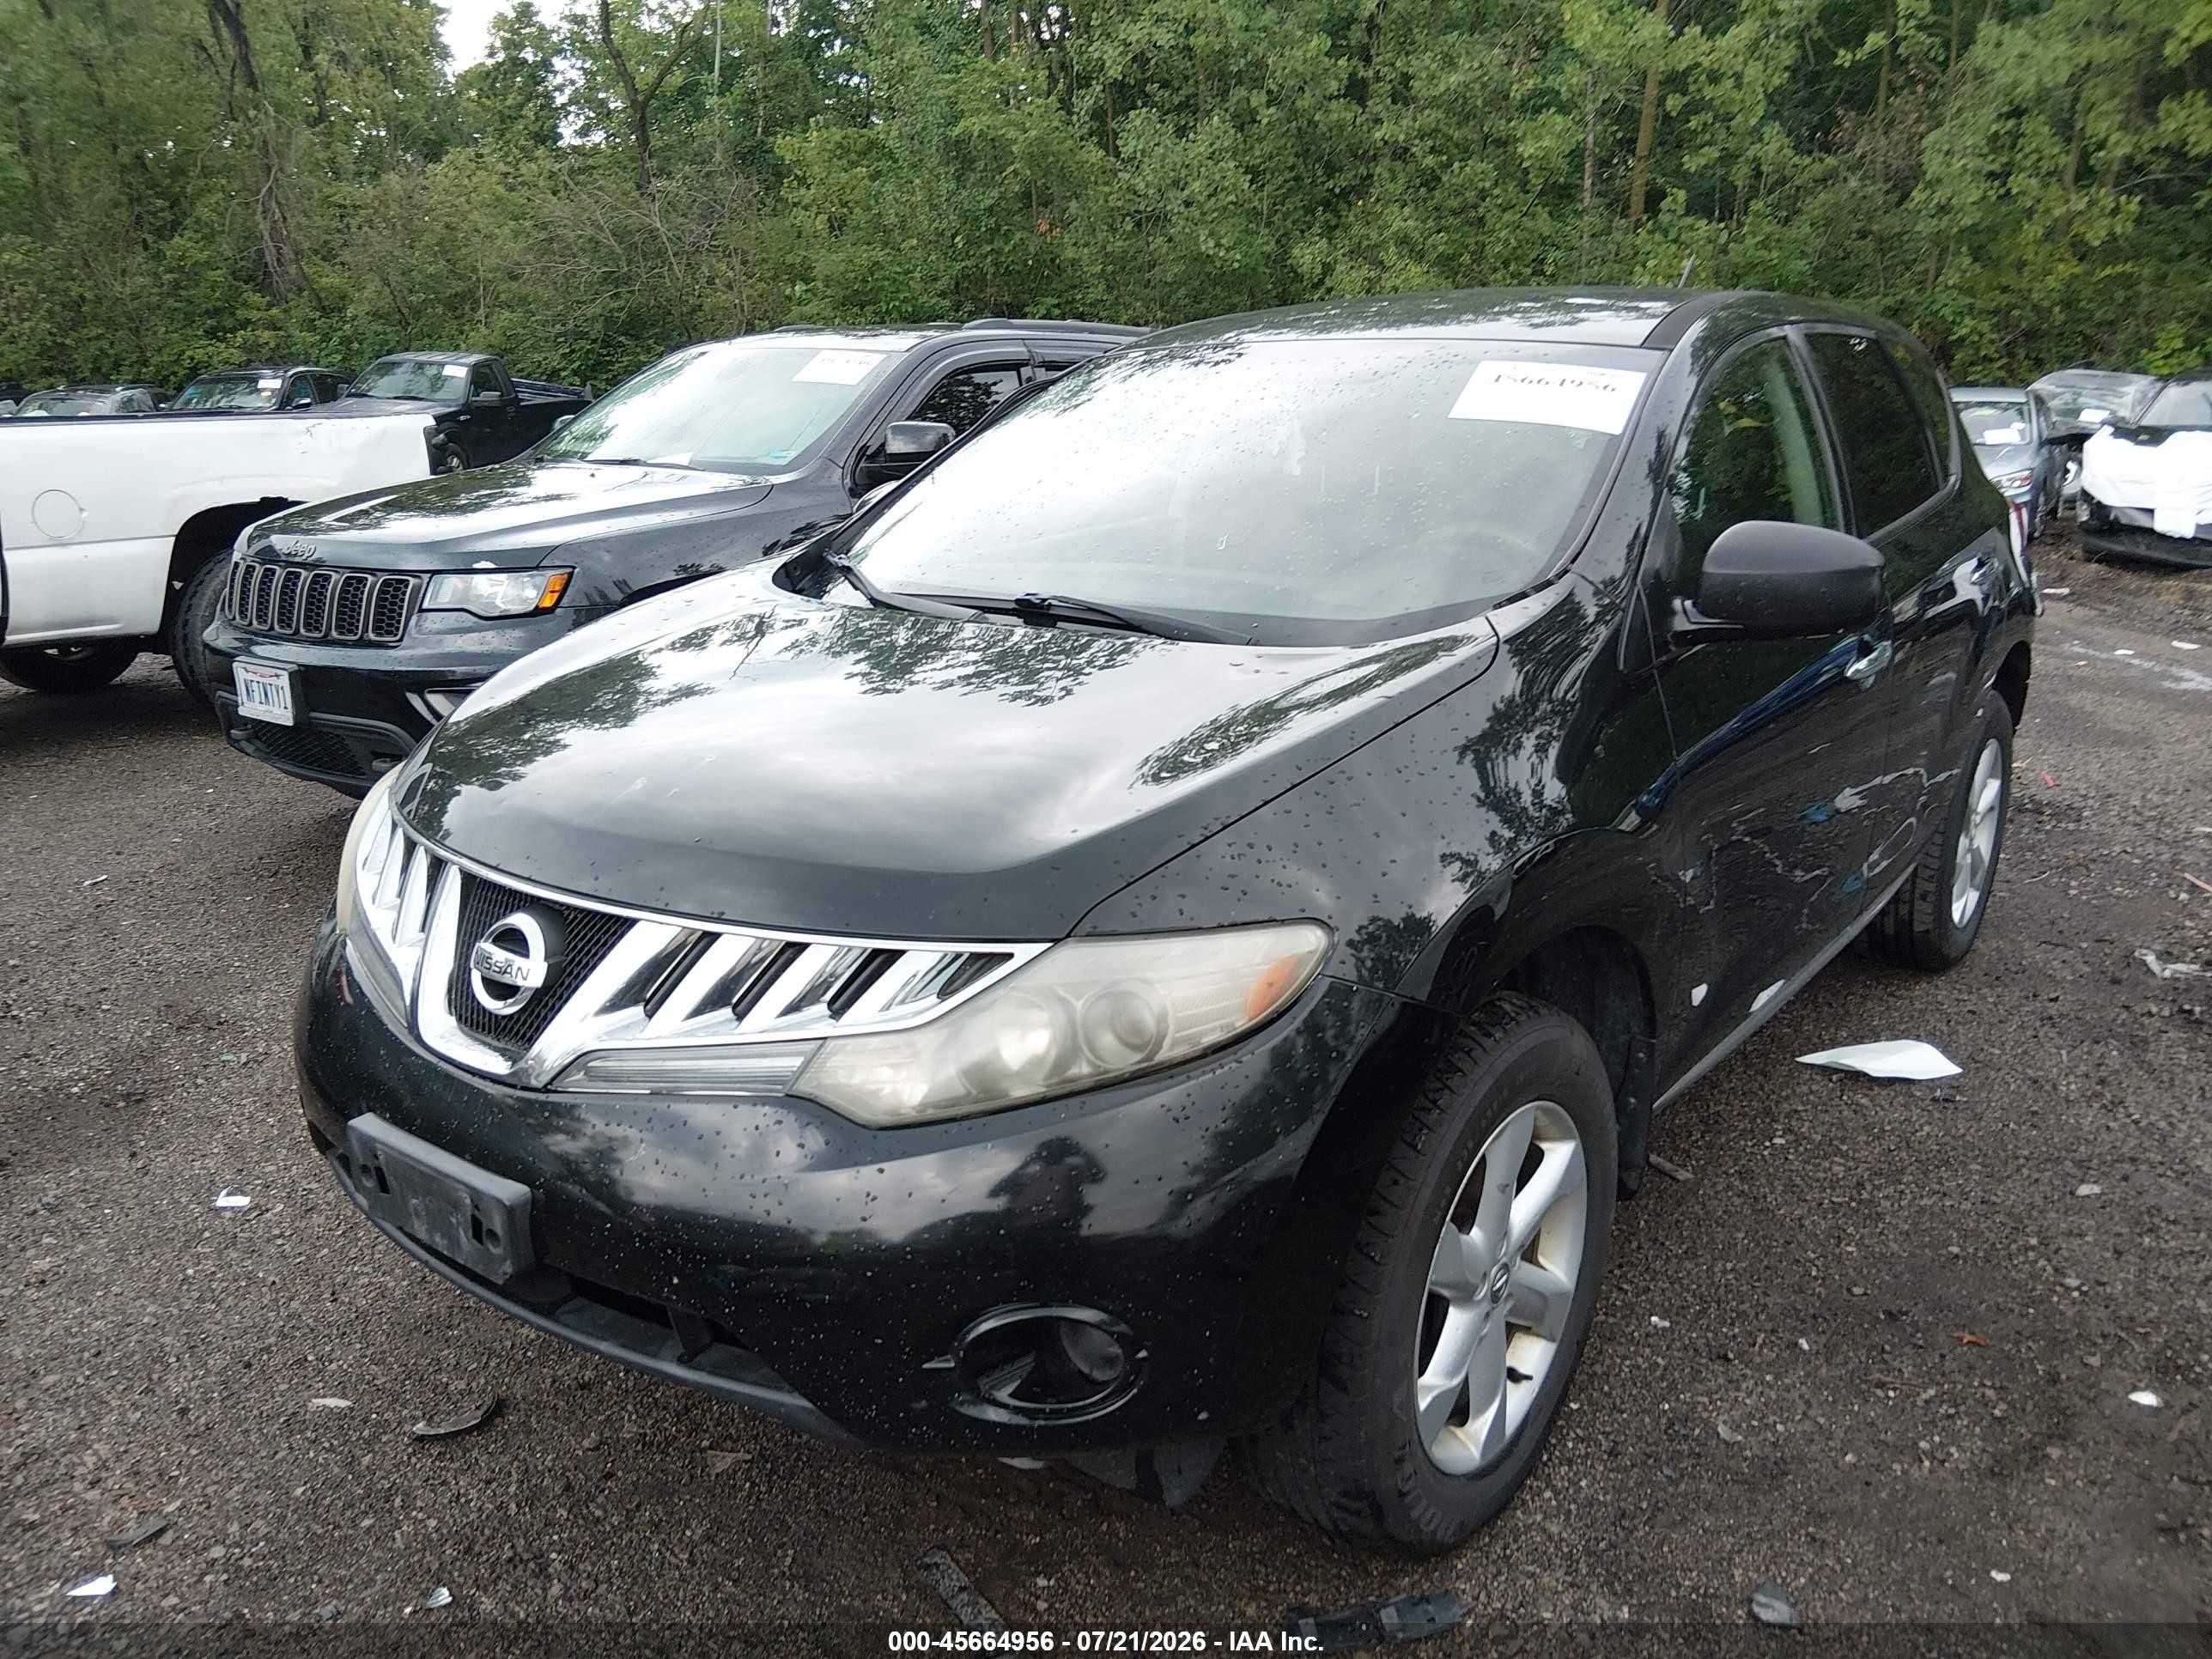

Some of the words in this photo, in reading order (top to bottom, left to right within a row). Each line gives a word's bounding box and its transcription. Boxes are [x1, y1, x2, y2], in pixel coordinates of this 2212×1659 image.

[280, 539, 317, 561] Jeep
[243, 678, 289, 710] NFINTY1
[474, 945, 531, 981] NISSAN
